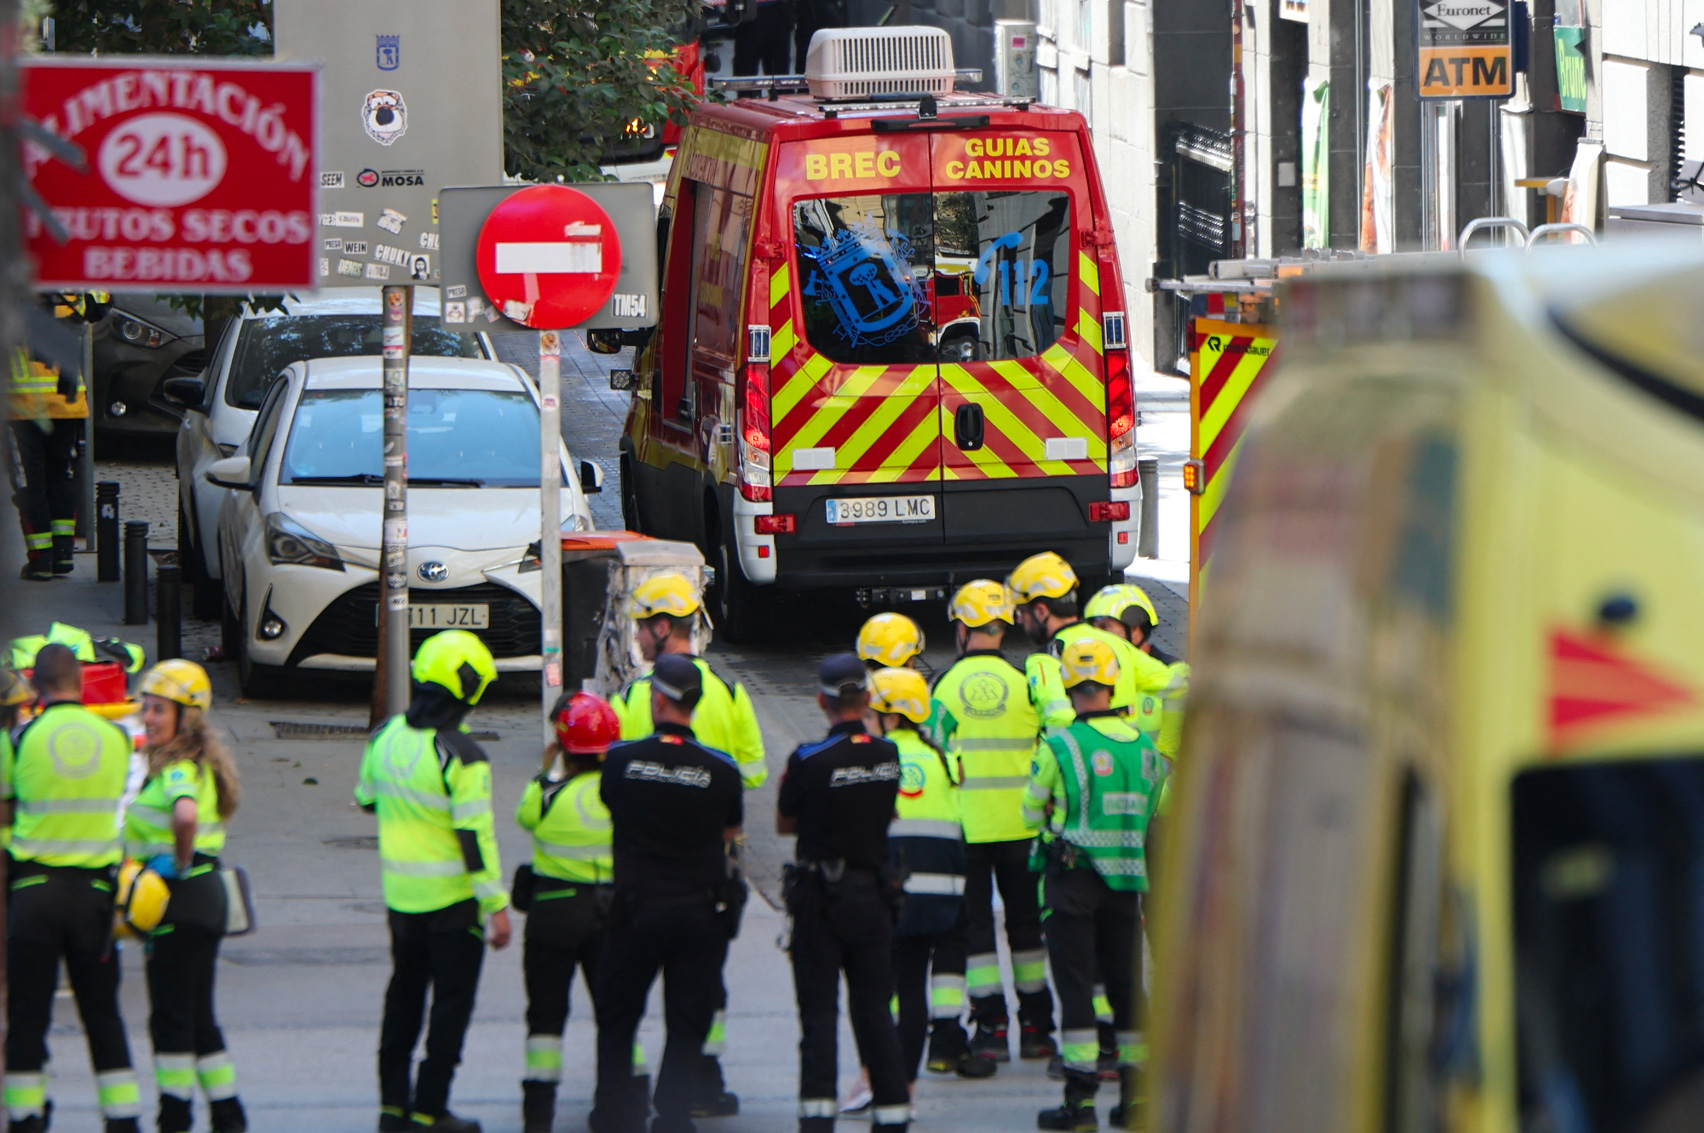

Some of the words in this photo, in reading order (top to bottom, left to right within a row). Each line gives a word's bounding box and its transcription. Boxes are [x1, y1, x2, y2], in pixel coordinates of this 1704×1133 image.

[1437, 3, 1491, 17] Euronet
[1424, 32, 1505, 41] WORLDWIDE
[1423, 57, 1507, 87] ATM
[114, 131, 212, 181] 24h
[965, 137, 1050, 157] GUIAS
[805, 150, 901, 181] BREC
[945, 159, 1070, 179] CANINOS
[381, 176, 424, 187] MOSA
[181, 209, 310, 245] SECOS
[345, 242, 367, 253] WEIN
[375, 244, 411, 267] CHUKY
[83, 245, 252, 283] BEBIDAS
[998, 259, 1049, 306] 112
[613, 294, 647, 317] TM54
[840, 500, 888, 519] 3989
[895, 499, 930, 517] LMC
[447, 608, 482, 625] JZL
